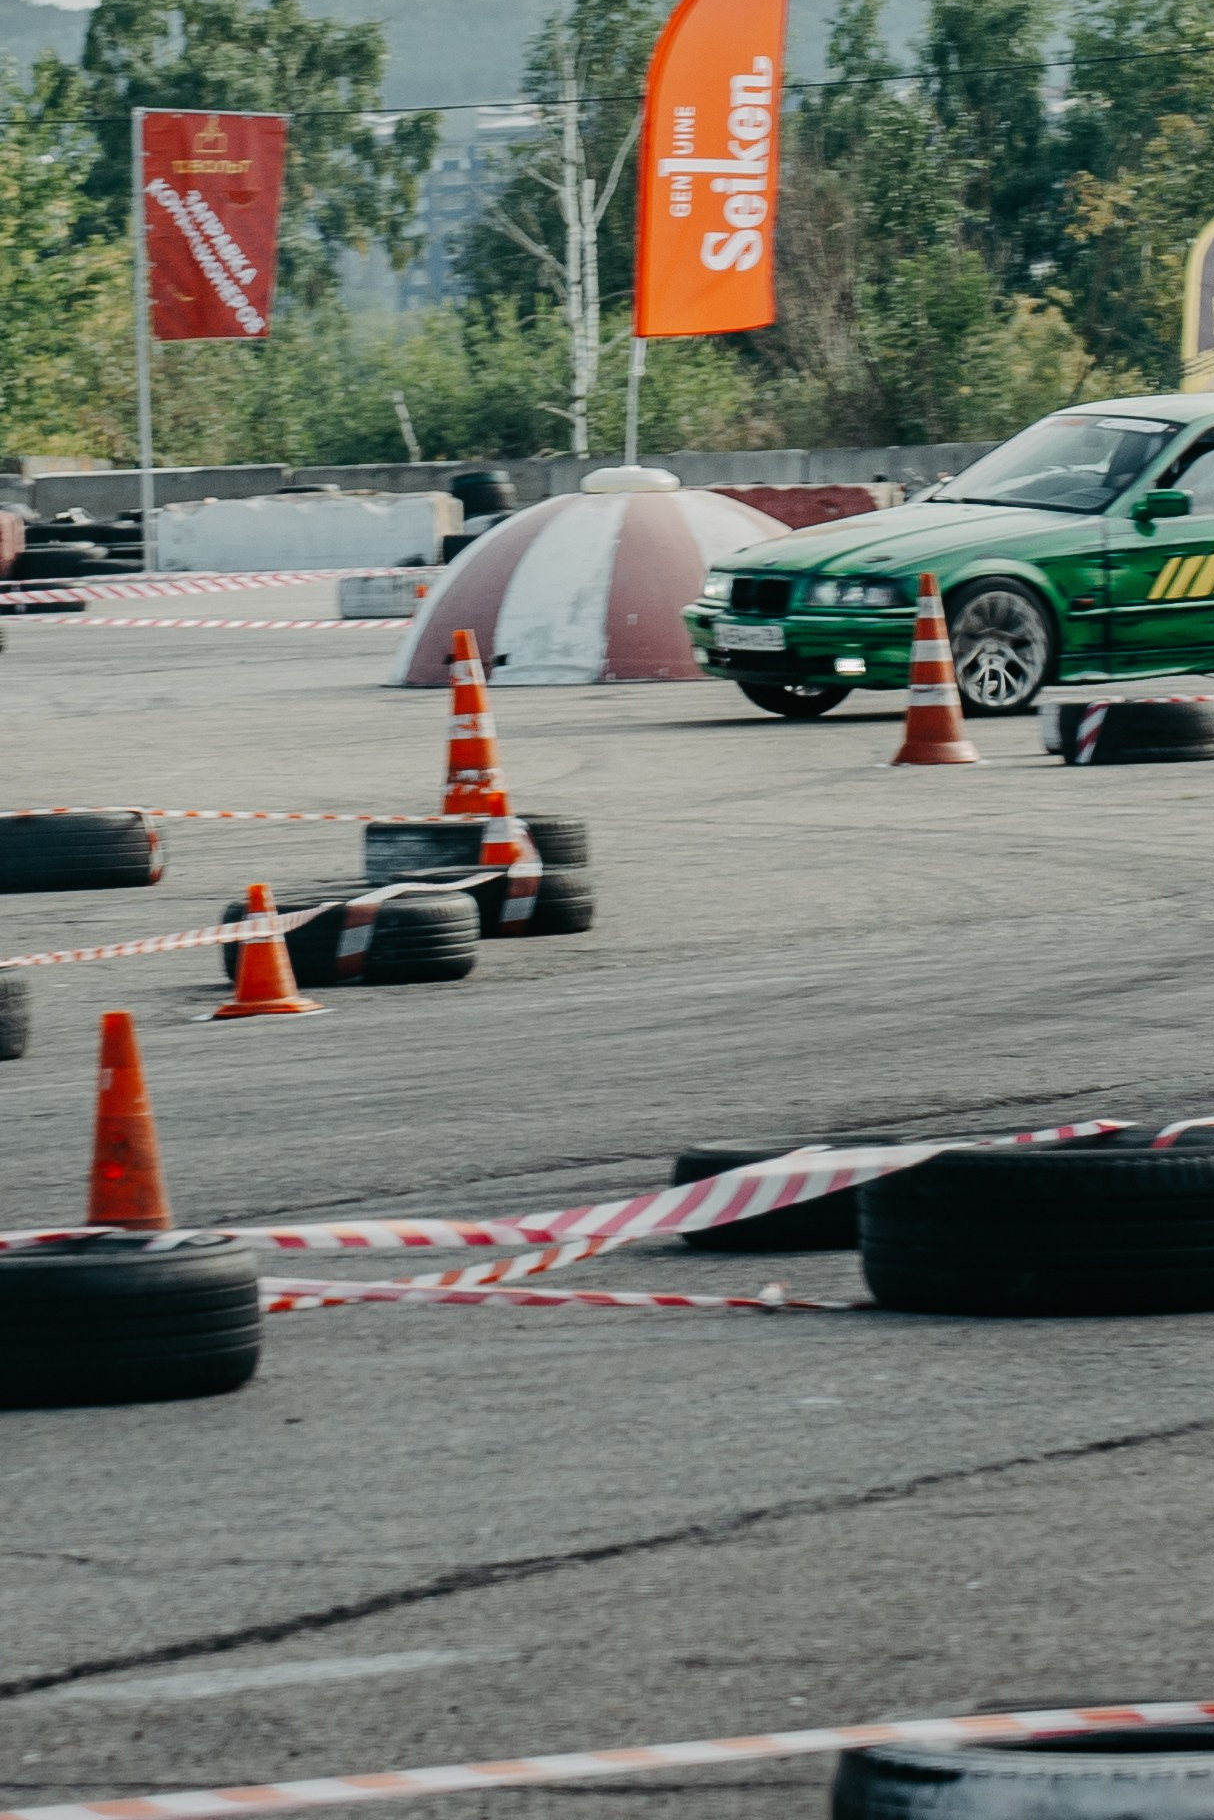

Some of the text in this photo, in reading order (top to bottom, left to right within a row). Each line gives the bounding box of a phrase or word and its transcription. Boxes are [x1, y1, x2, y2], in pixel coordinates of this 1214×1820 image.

[658, 55, 773, 272] Seiken
[669, 105, 696, 218] GENUINE
[186, 190, 257, 285] ЗАПРАВКА
